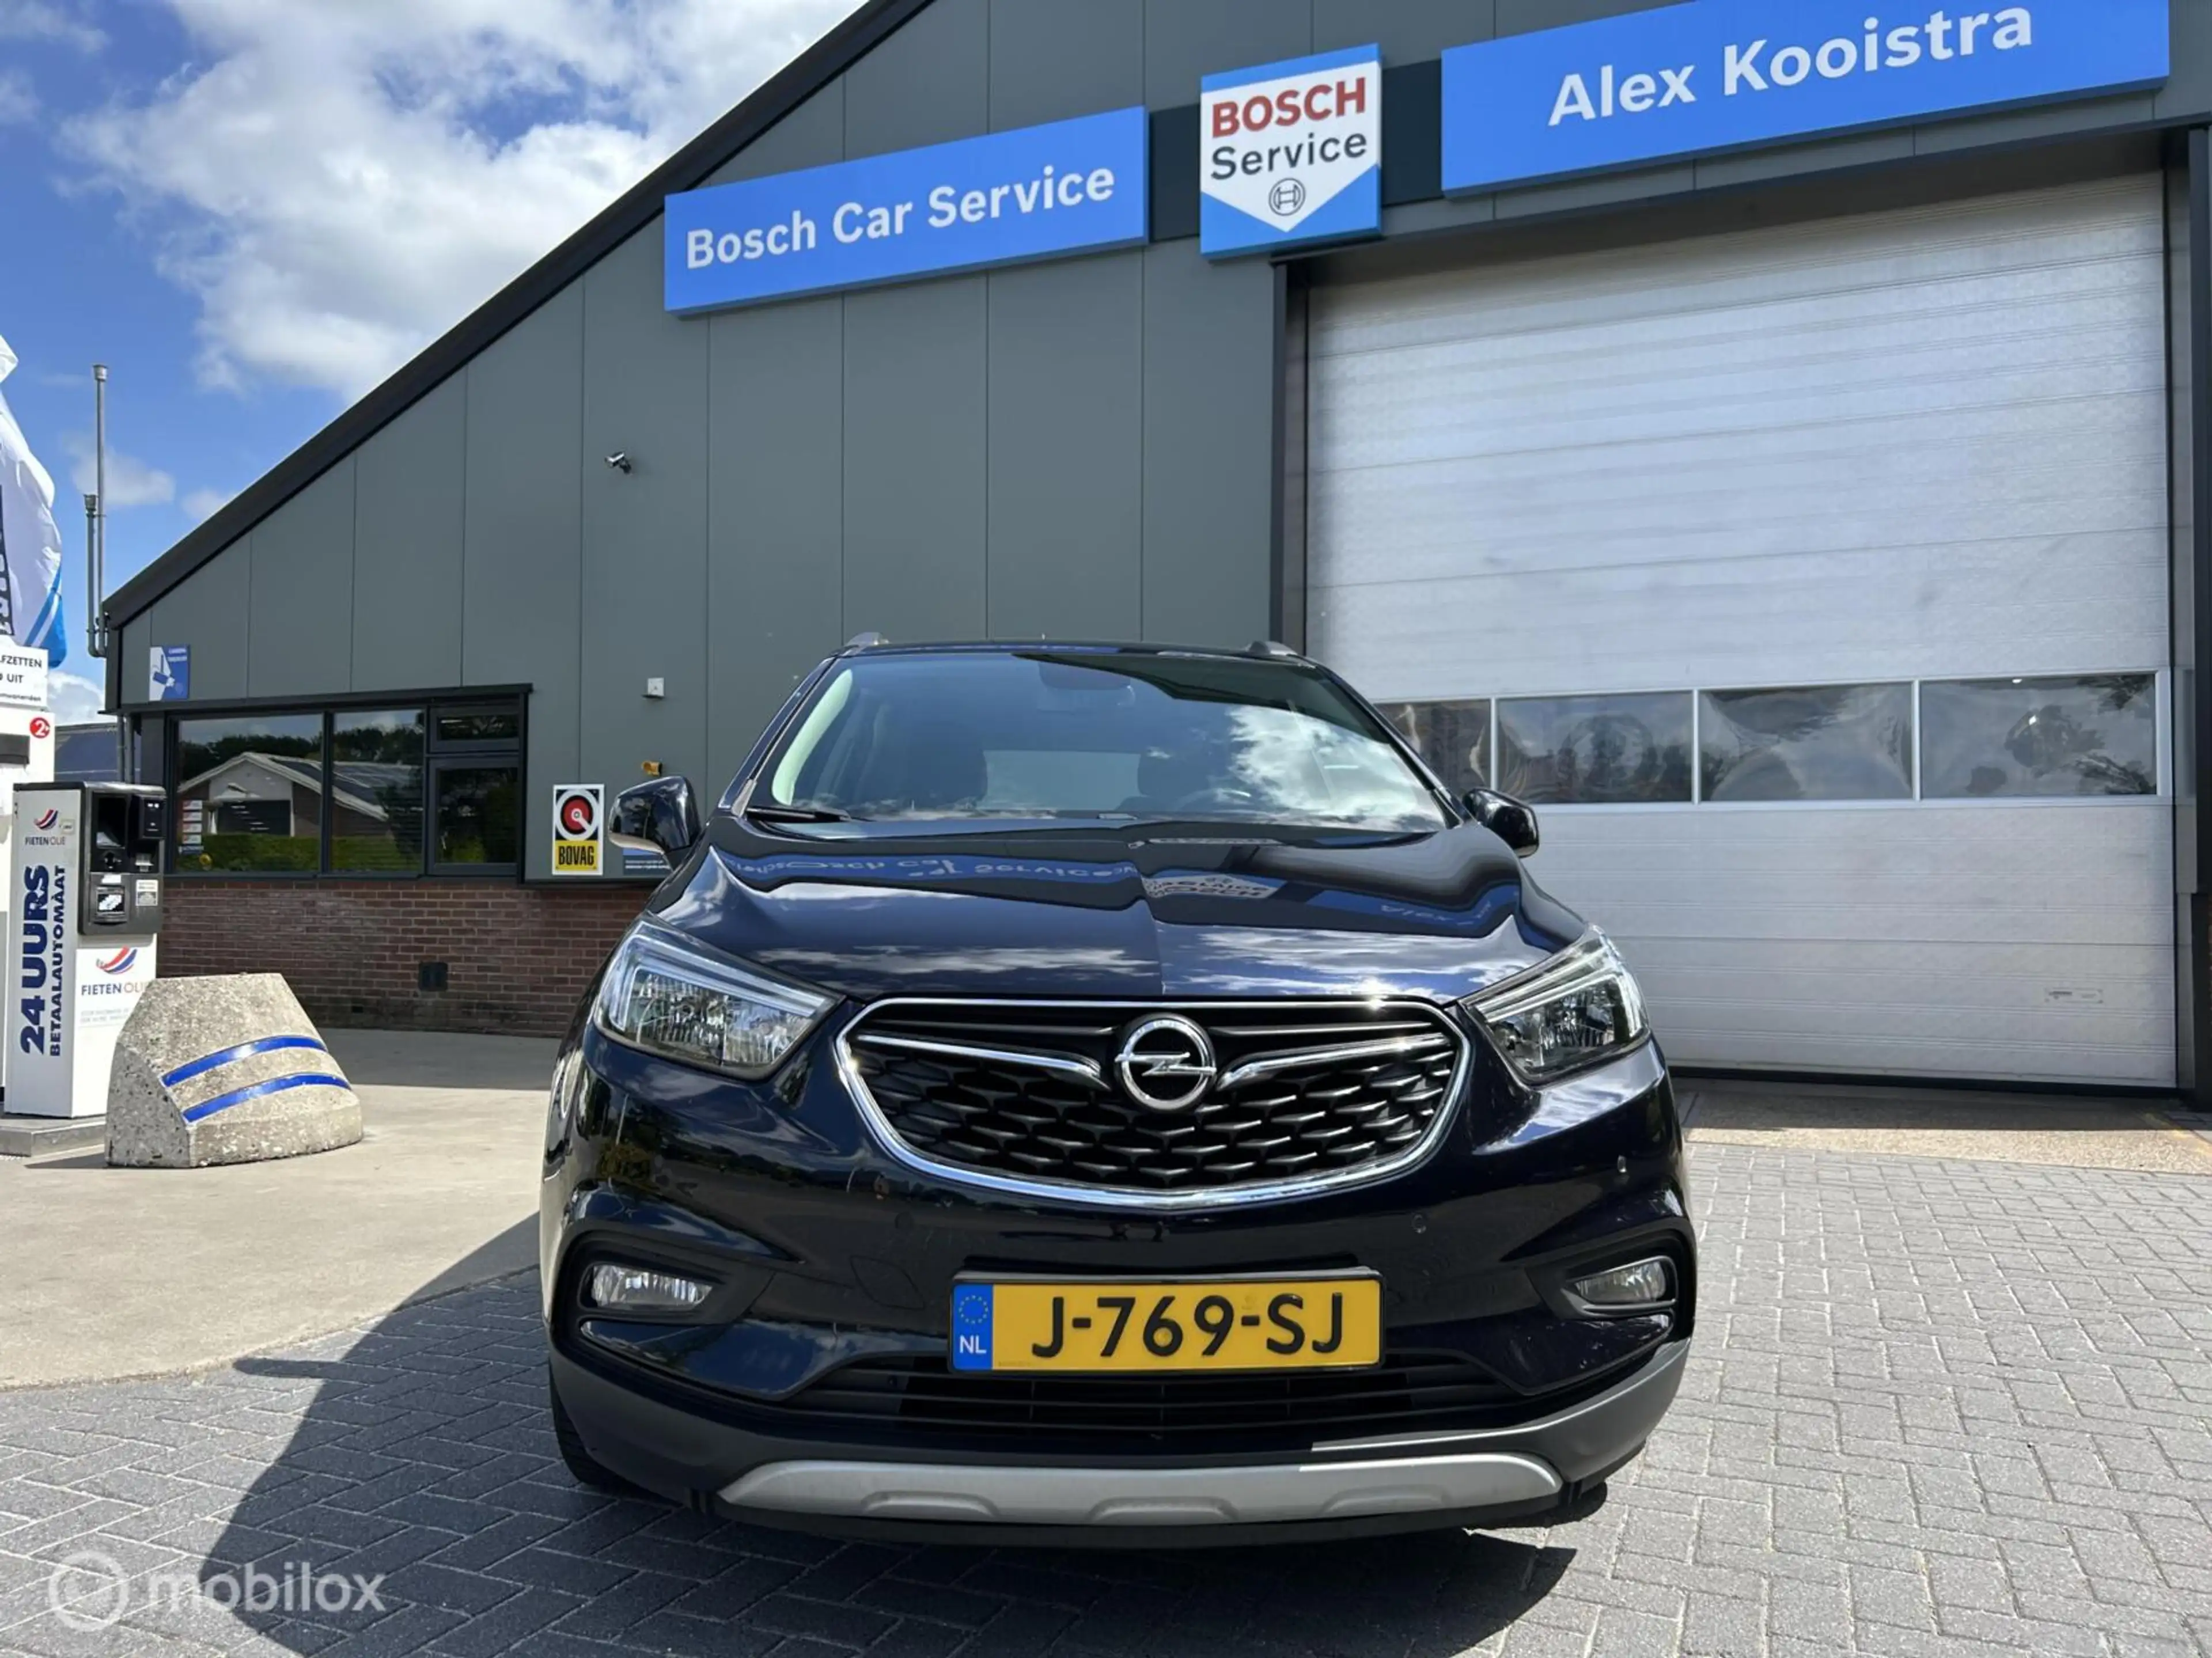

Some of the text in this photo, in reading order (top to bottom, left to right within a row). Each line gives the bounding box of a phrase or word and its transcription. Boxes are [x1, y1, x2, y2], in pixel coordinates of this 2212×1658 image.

[1547, 7, 2032, 126] Alex Kooistra
[1213, 77, 1366, 138] BOSCH
[1211, 132, 1367, 180] Service
[687, 165, 1115, 268] Bosch Car Service
[0, 655, 42, 668] FZETTEN
[6, 673, 24, 684] UIT
[25, 836, 49, 846] FIETEN
[558, 845, 594, 866] BOVAG
[20, 865, 49, 1055] 24 UURS
[81, 982, 122, 996] FIETEN
[959, 1292, 1343, 1358] NL J-769-SJ
